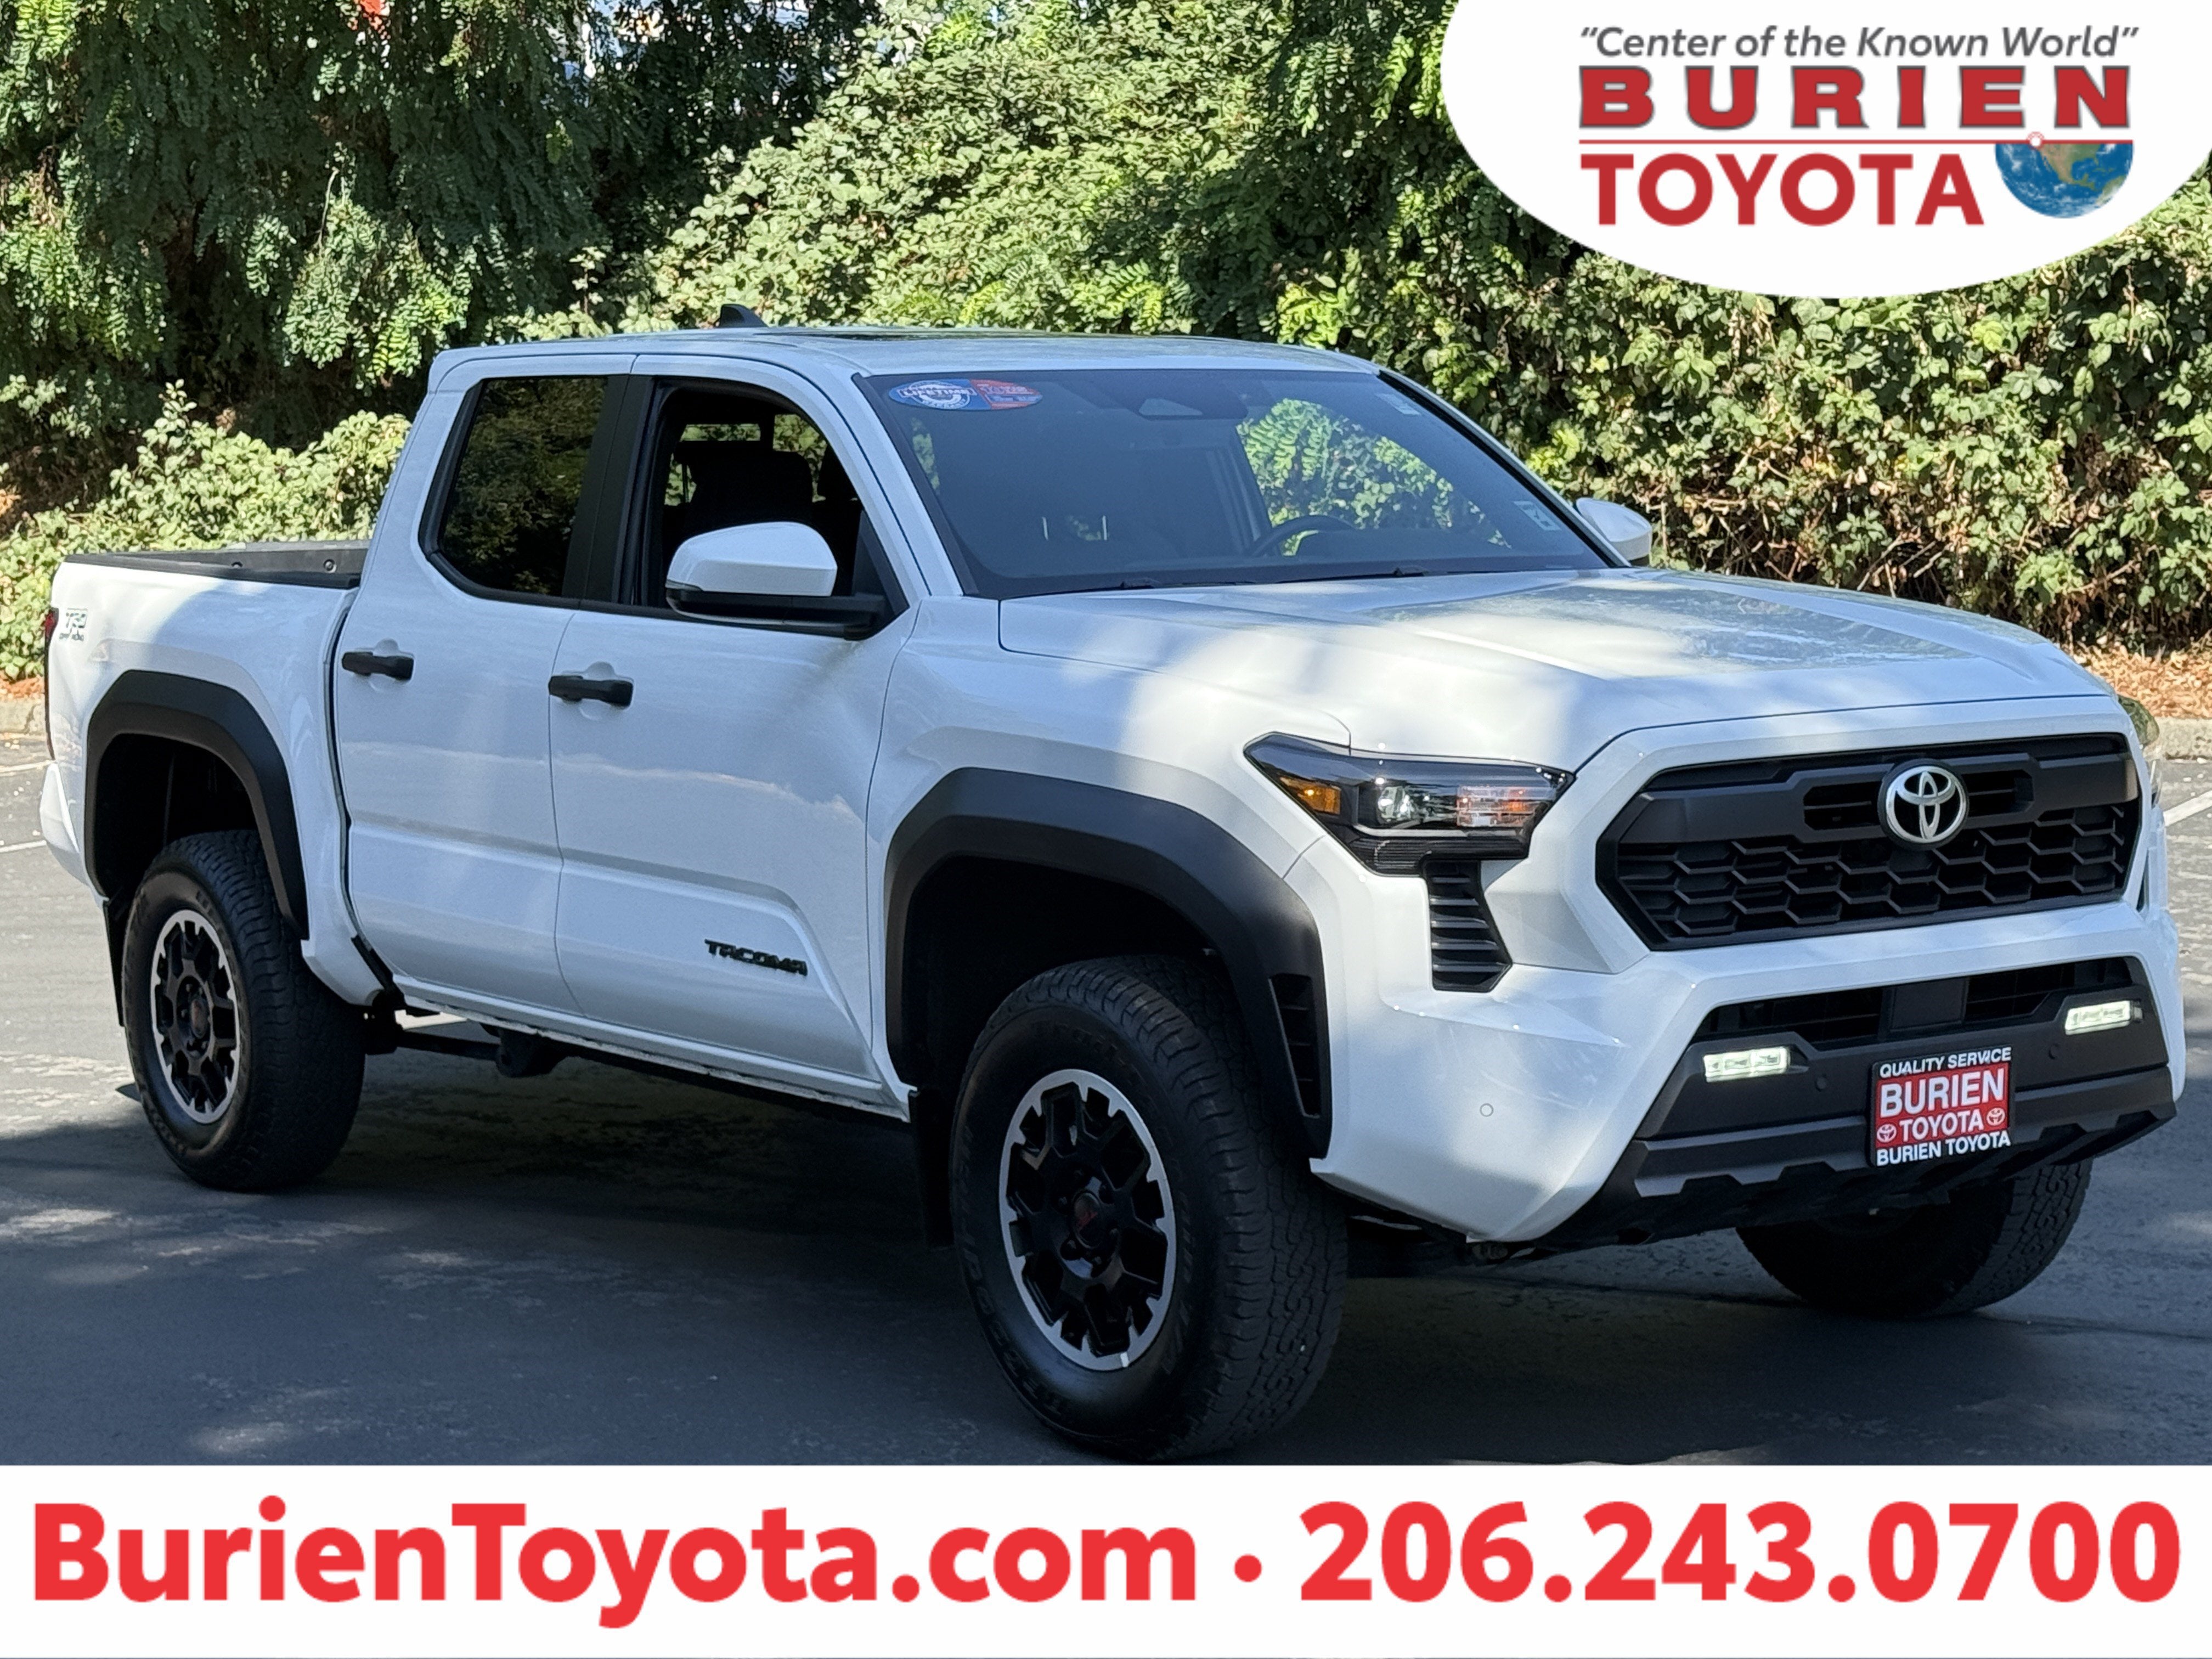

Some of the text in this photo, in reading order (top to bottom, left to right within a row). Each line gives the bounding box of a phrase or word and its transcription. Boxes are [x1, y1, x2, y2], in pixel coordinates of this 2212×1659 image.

[704, 939, 808, 976] TACOMA
[1880, 1047, 2012, 1079] QUALITY SERVICE
[1880, 1068, 2005, 1119] BURIEN
[1899, 1109, 1984, 1142] TOYOTA
[1876, 1130, 2011, 1166] BURIEN TOYOTA
